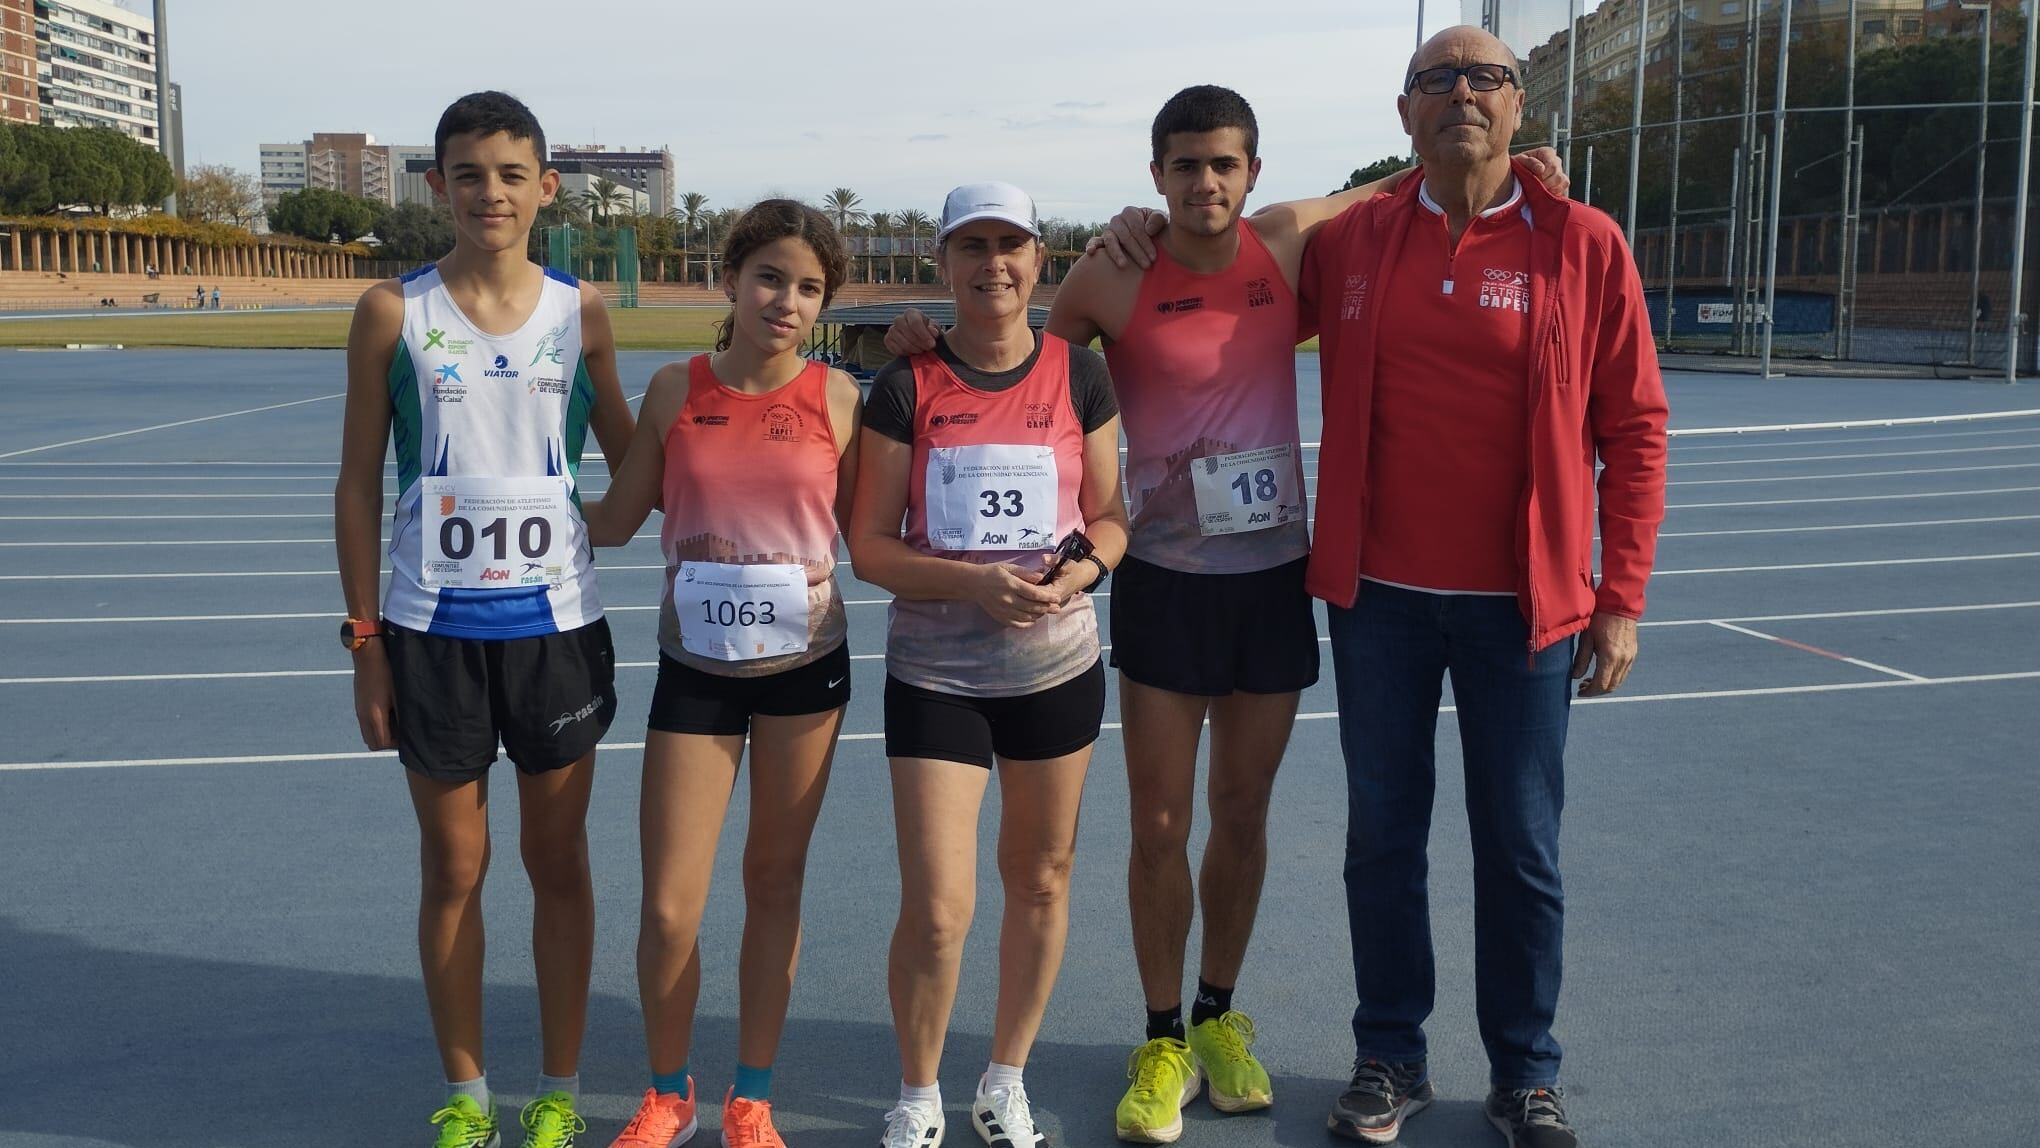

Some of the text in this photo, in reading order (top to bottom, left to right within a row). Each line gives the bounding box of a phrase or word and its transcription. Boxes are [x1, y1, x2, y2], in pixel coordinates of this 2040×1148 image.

[1481, 285, 1529, 302] PETRER
[1479, 294, 1528, 314] CAPET
[484, 369, 519, 378] VIATOR
[432, 387, 467, 395] Fundación
[1026, 420, 1054, 429] CAPET
[1231, 468, 1278, 505] 18
[464, 497, 506, 505] FEDERACIÓN
[979, 489, 1025, 518] 33
[439, 516, 552, 561] 010
[701, 599, 776, 627] 1063
[574, 695, 604, 722] rasán
